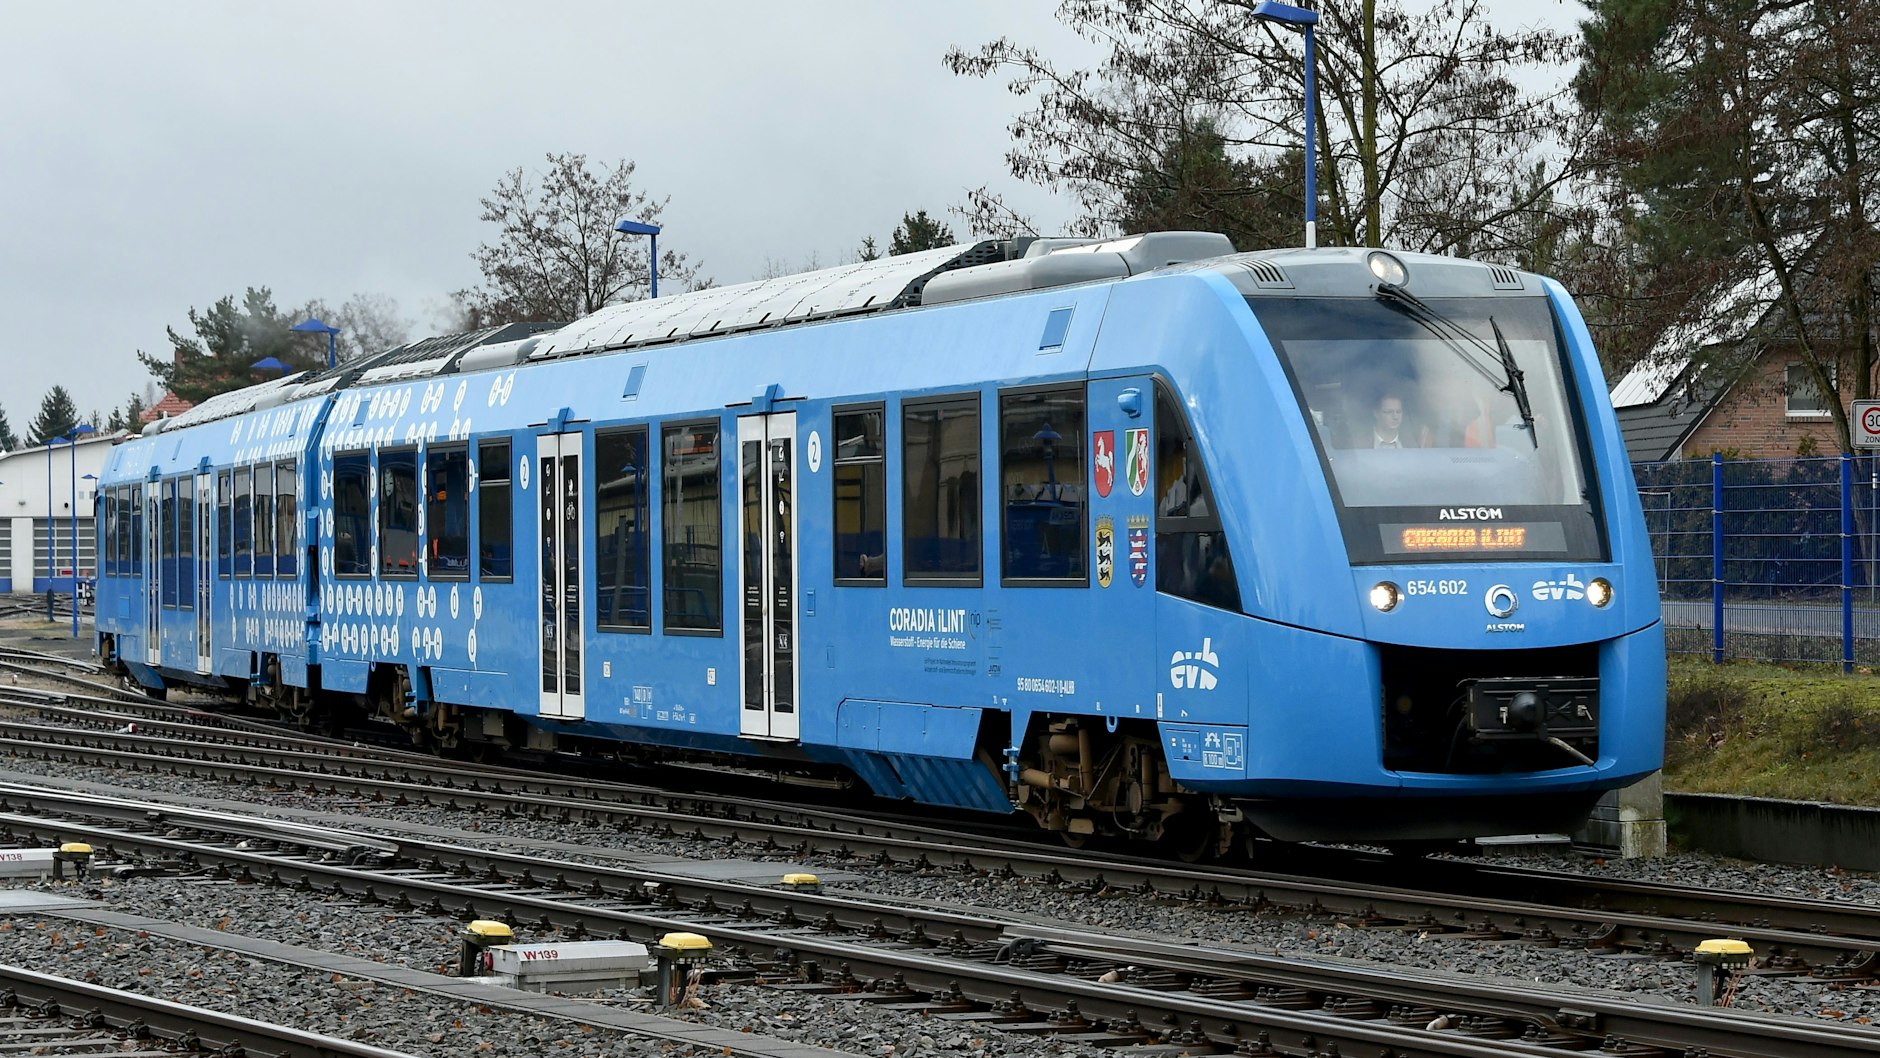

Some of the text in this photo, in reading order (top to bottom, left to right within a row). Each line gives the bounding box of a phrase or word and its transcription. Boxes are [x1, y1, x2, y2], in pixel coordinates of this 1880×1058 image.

[1867, 414, 1880, 427] 30
[812, 441, 817, 463] 2
[1439, 507, 1503, 520] ALSTOM
[1407, 580, 1468, 595] 654 602
[1532, 573, 1585, 601] evb
[889, 607, 936, 632] CORADIA
[938, 608, 966, 633] iLINT
[1486, 623, 1525, 632] ALSTOM
[1170, 637, 1219, 690] evb
[1017, 677, 1024, 691] 95
[1025, 678, 1031, 691] 80
